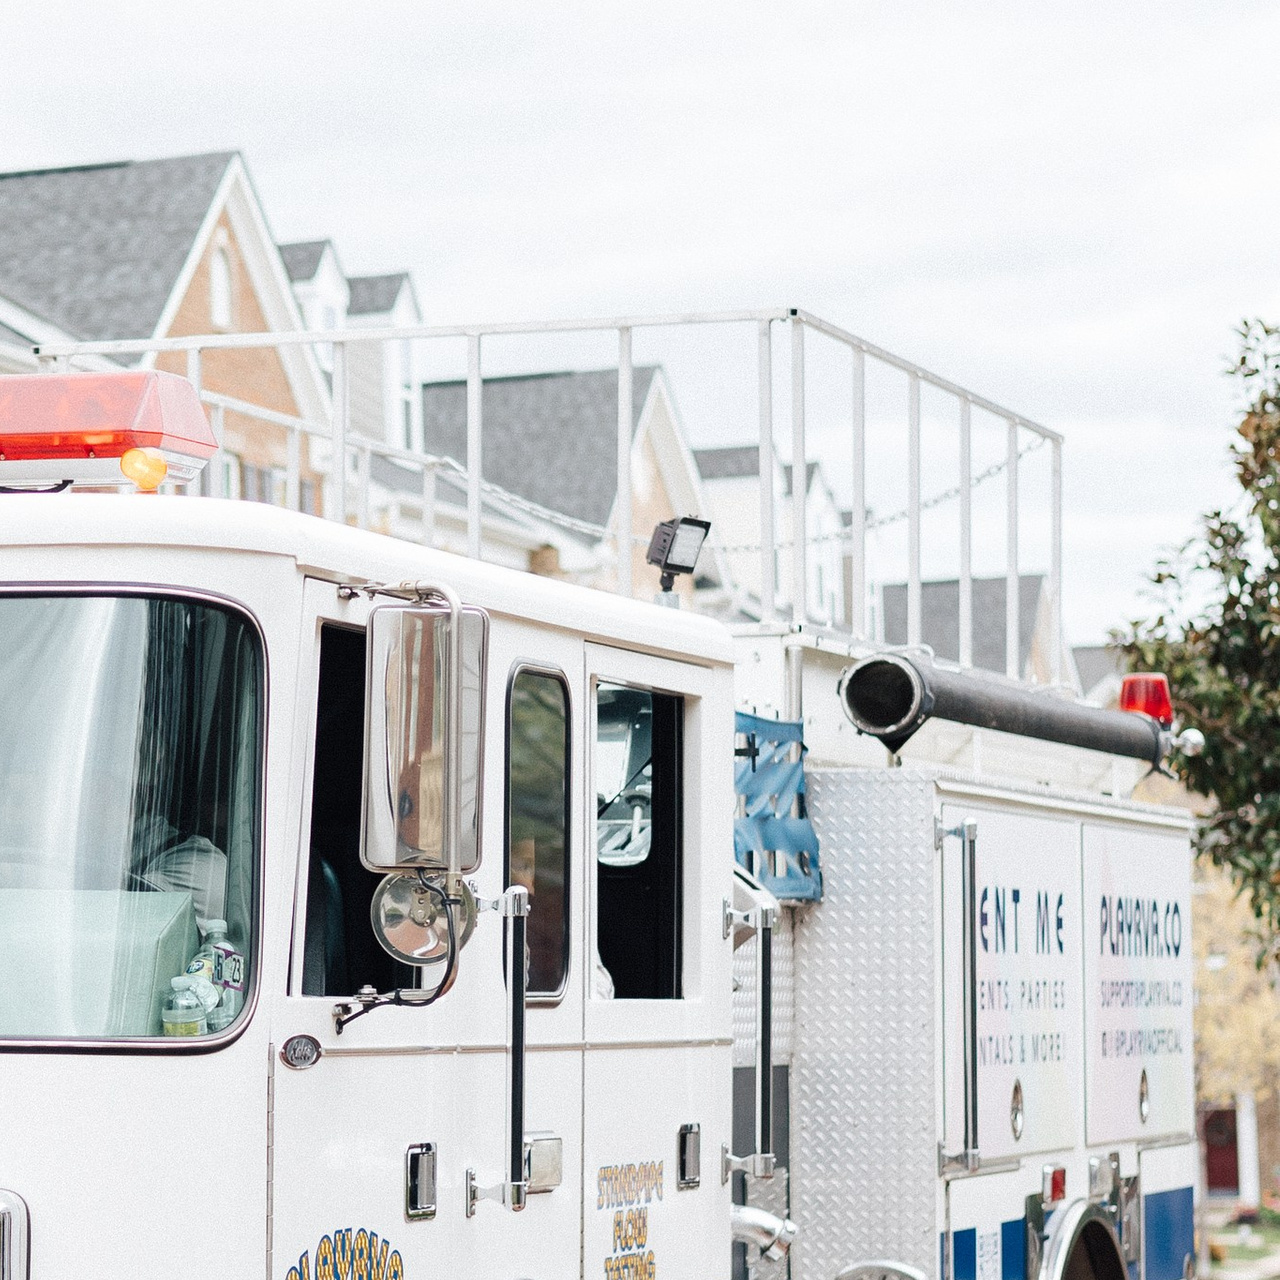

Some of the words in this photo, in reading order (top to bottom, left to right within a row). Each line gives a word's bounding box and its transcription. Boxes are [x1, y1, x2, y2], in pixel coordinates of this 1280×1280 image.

[980, 886, 1020, 954] ENT
[1036, 890, 1064, 955] ME
[1100, 895, 1182, 958] PLAYRVA.CO
[980, 980, 1014, 1015] ENTS,
[1021, 980, 1065, 1010] PARTIES
[979, 1034, 1014, 1067] NTALS
[597, 1160, 663, 1210] STANDPIPE
[613, 1207, 648, 1253] FLOW
